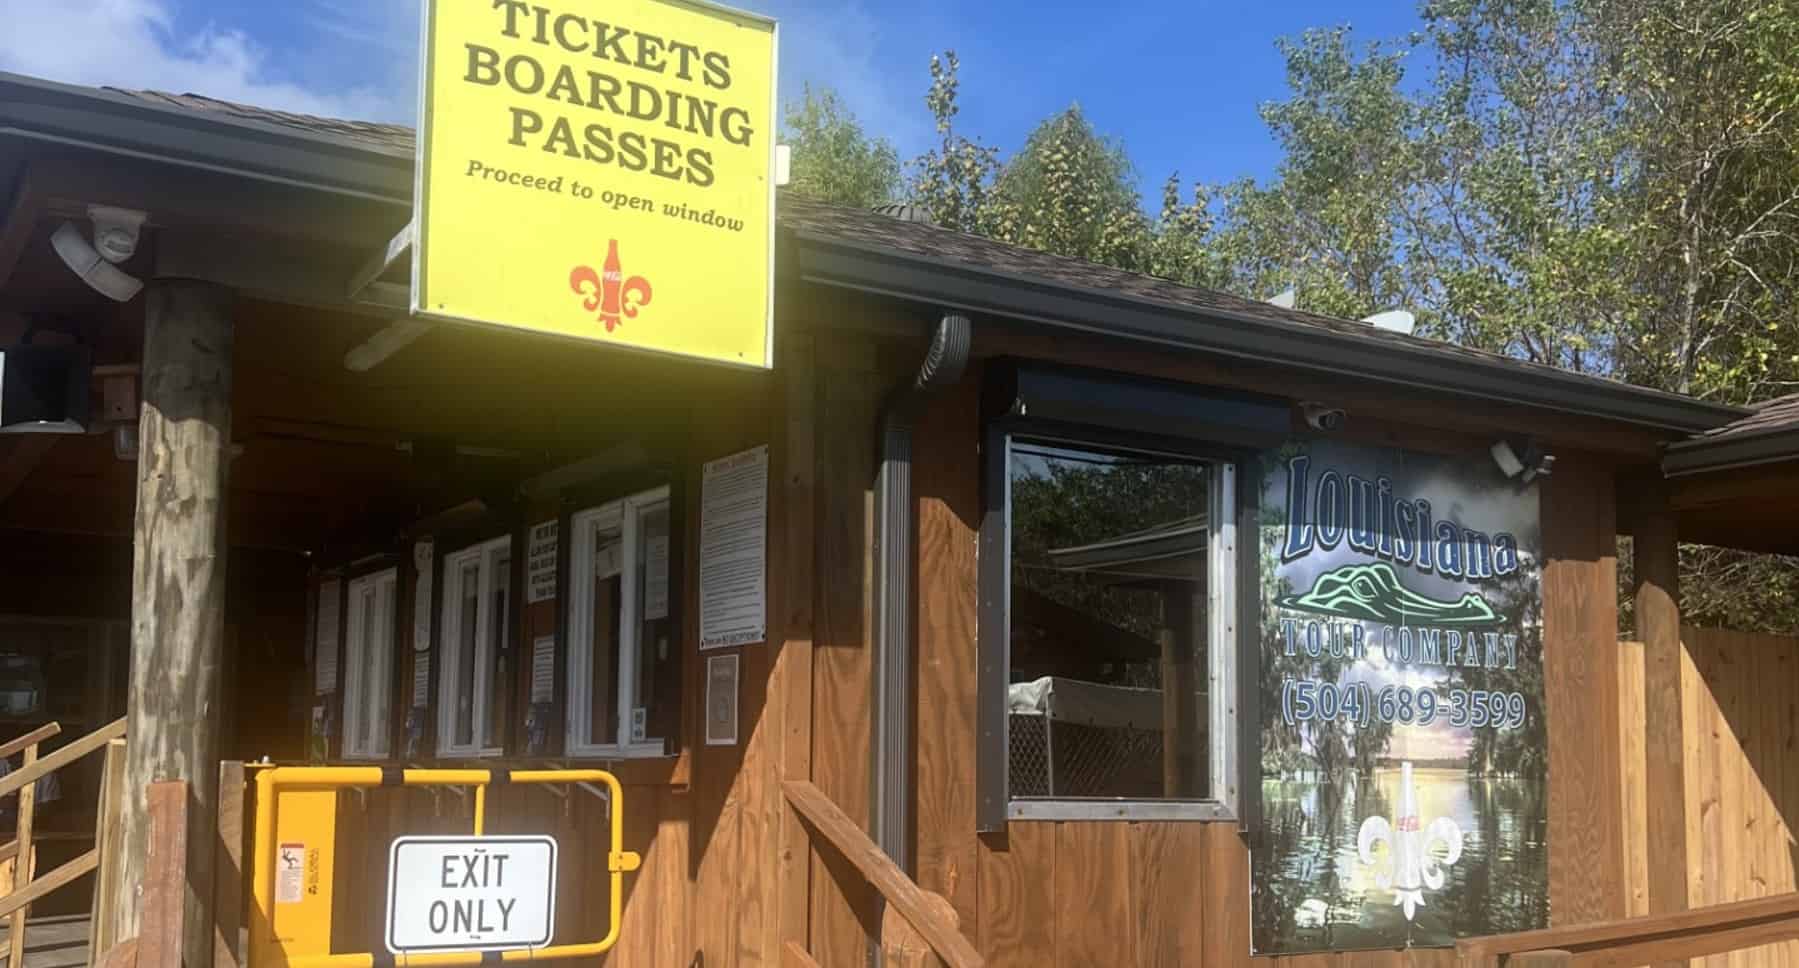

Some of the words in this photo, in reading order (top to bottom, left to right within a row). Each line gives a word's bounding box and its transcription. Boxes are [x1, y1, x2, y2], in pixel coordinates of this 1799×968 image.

[493, 0, 732, 90] TICKETS
[463, 43, 754, 147] BOARDING
[508, 106, 715, 187] PASSES
[465, 159, 563, 193] Proceed
[571, 180, 594, 199] to
[601, 190, 654, 213] open
[662, 203, 744, 232] window
[1280, 455, 1520, 581] Louisiana
[1280, 617, 1366, 658] TOUR
[1382, 625, 1518, 669] COMPANY
[1281, 678, 1371, 729] (504)
[1378, 685, 1525, 728] 689-3599
[441, 854, 509, 888] EXIT
[429, 898, 516, 934] ONLY
